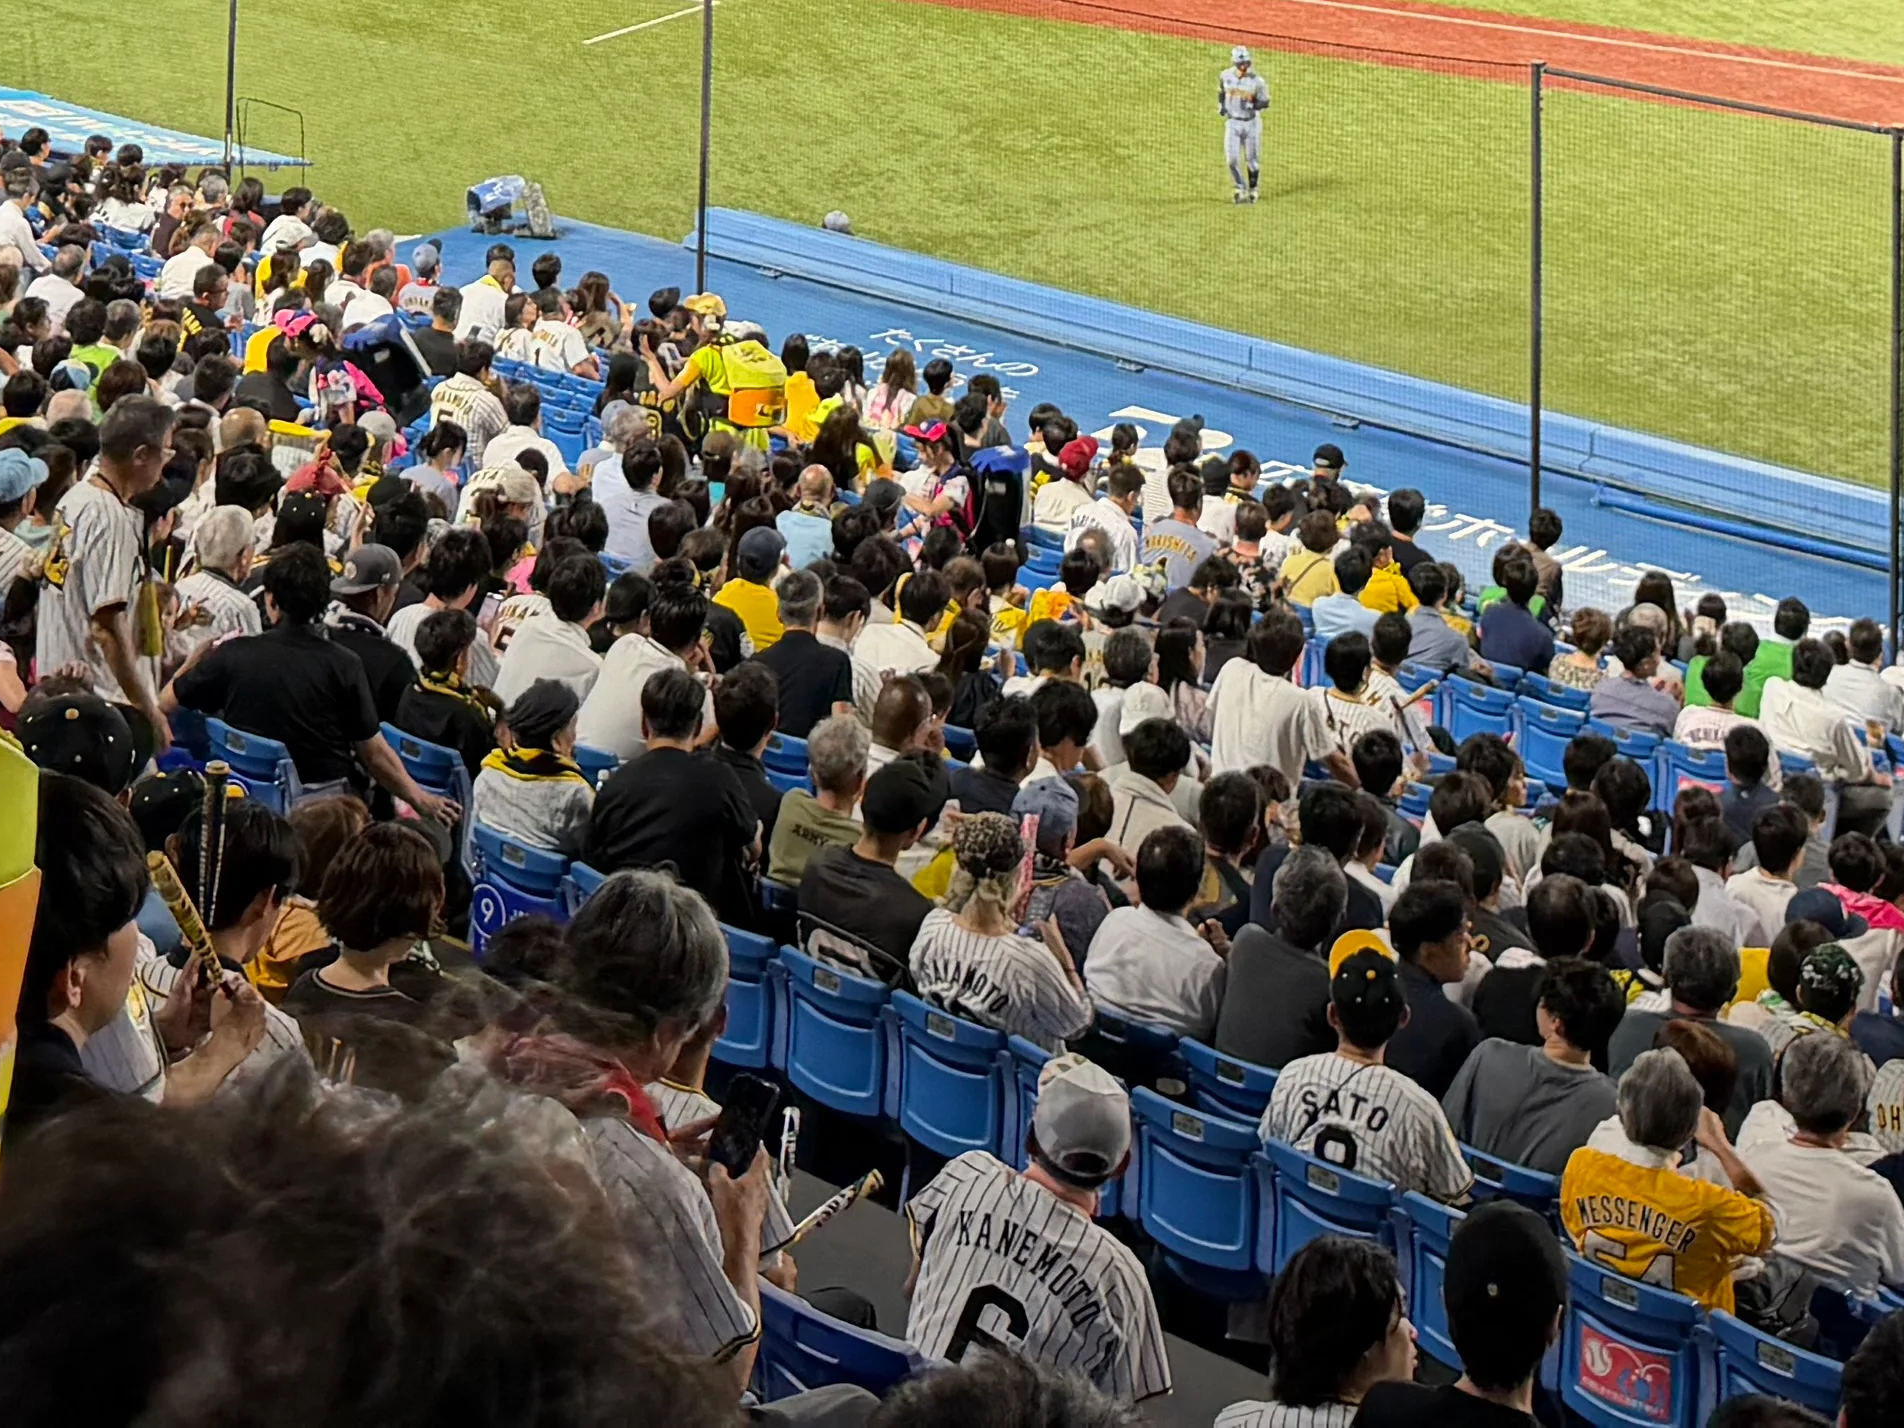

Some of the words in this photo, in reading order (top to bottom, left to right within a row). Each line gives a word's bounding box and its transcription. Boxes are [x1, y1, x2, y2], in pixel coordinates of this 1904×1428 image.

[791, 826, 835, 846] ARMY
[480, 897, 496, 924] 9
[1299, 1086, 1390, 1133] SATO
[1575, 1191, 1695, 1254] MESSENGER
[958, 1206, 1102, 1329] KANEMOTO
